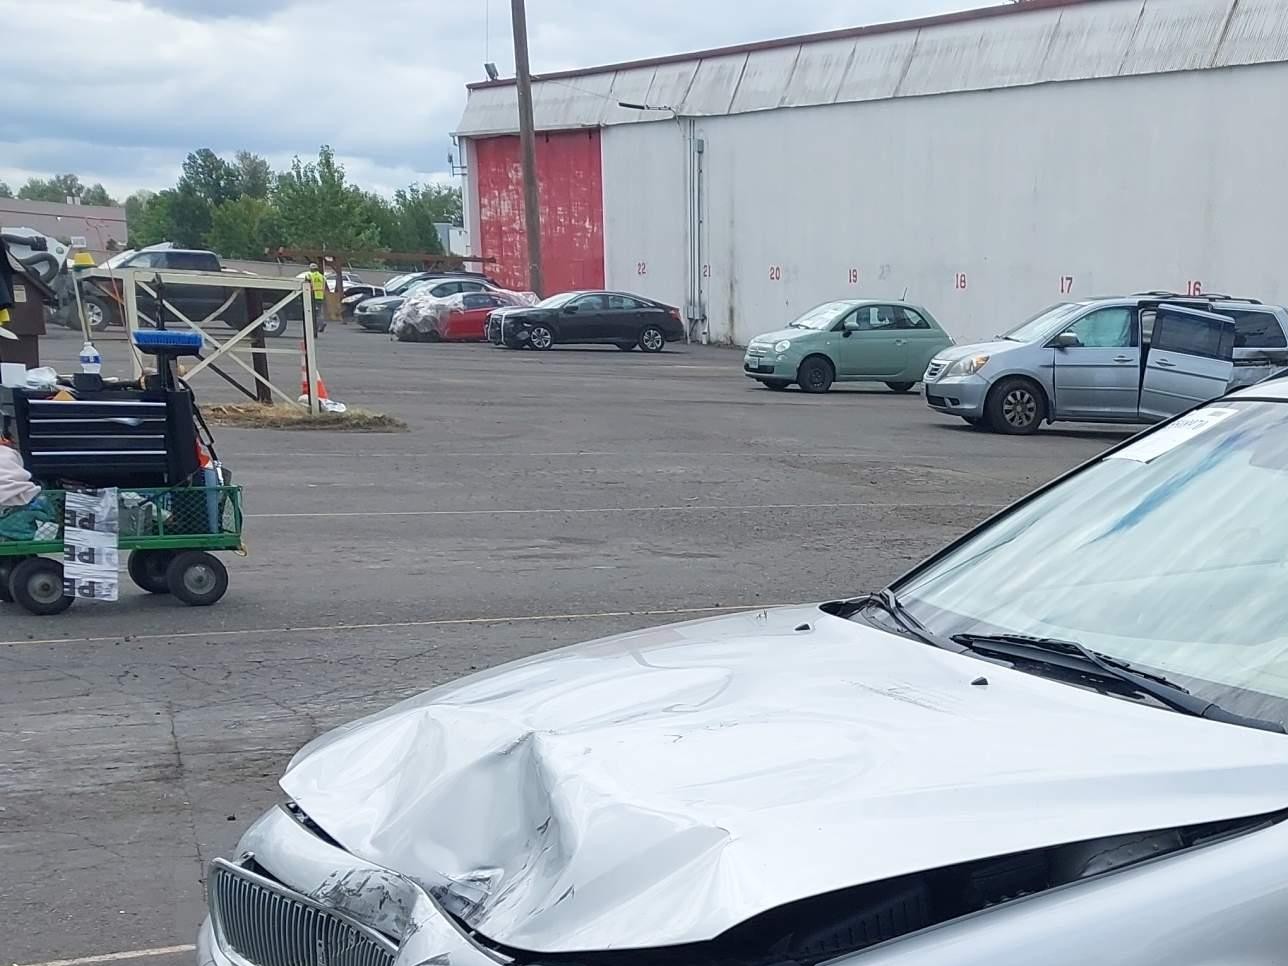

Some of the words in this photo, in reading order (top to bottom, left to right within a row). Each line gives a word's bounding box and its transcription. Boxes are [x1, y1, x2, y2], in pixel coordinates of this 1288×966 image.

[637, 262, 646, 275] 22
[703, 264, 711, 278] 21
[769, 266, 781, 281] 20
[849, 269, 858, 284] 19
[956, 273, 967, 289] 18
[1060, 276, 1073, 294] 17
[1187, 280, 1202, 296] 16
